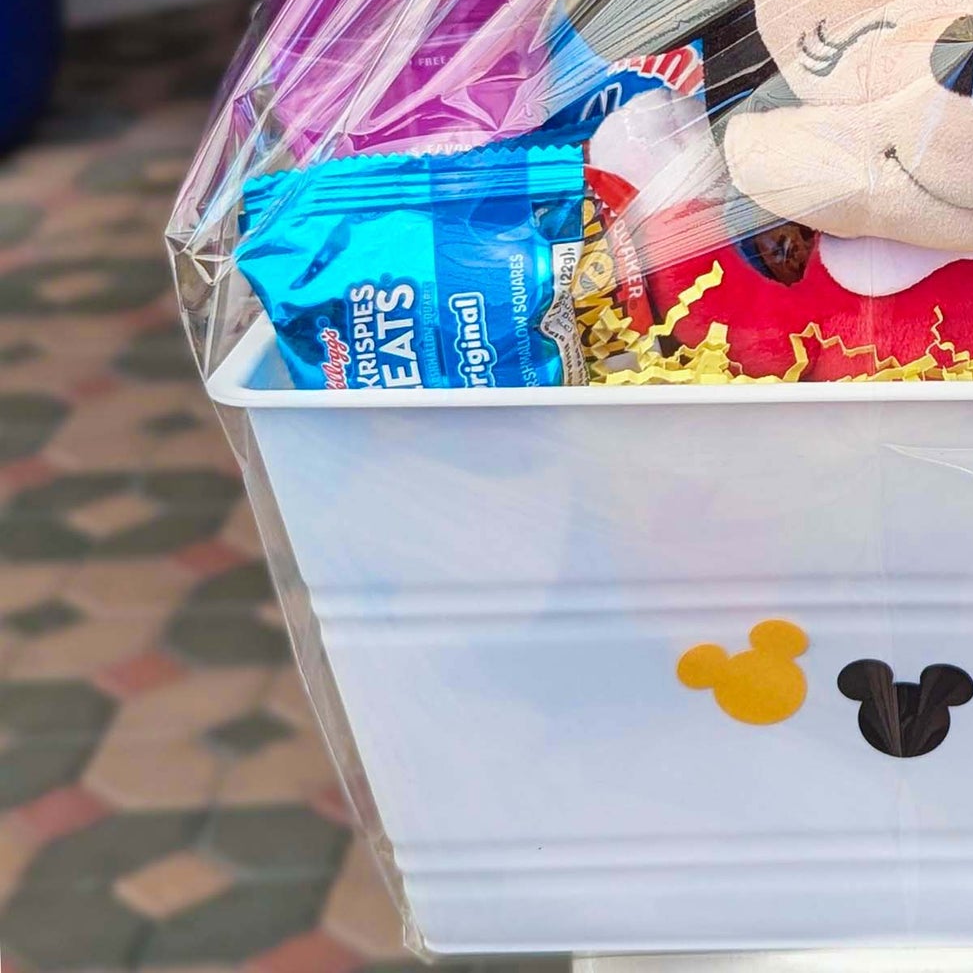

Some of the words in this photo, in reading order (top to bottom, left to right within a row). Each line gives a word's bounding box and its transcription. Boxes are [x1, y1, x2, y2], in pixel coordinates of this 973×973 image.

[509, 254, 527, 313] SQUARES
[613, 220, 643, 298] QUAKER
[350, 284, 383, 388] KRISPIES
[377, 284, 421, 388] EATS
[455, 298, 491, 387] riginal
